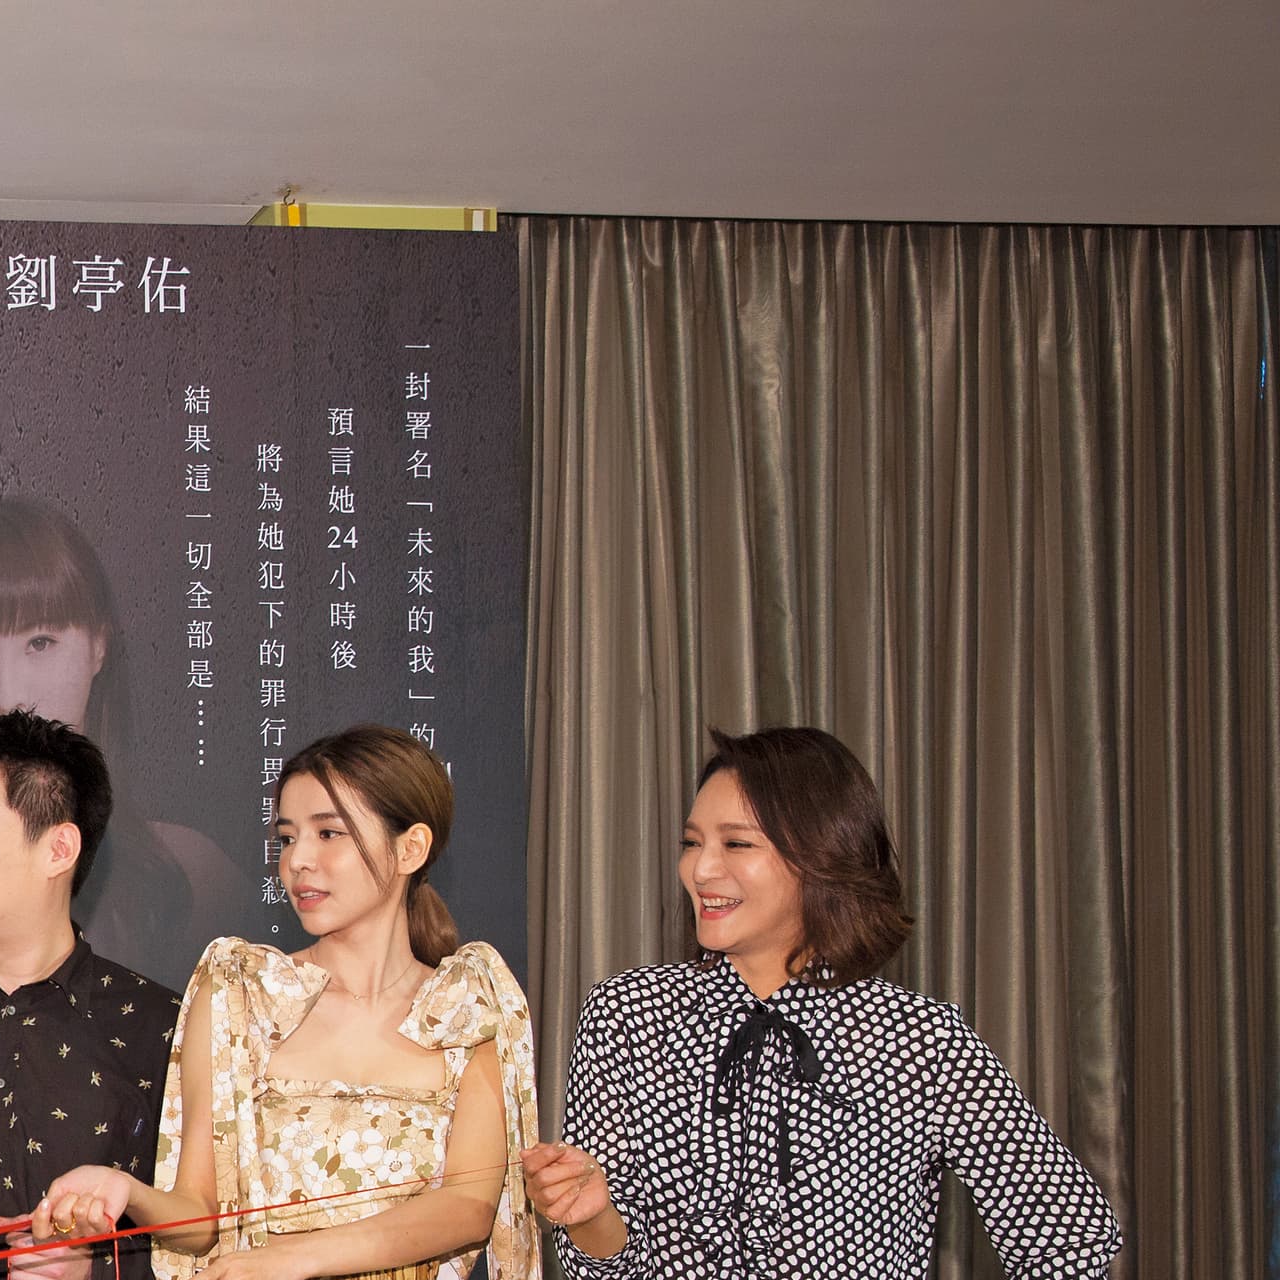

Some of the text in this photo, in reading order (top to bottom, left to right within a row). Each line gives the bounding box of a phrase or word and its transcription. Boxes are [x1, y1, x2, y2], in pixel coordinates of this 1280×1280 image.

[5, 253, 191, 313] 劉亭佑
[327, 407, 358, 671] 預言她24小時後
